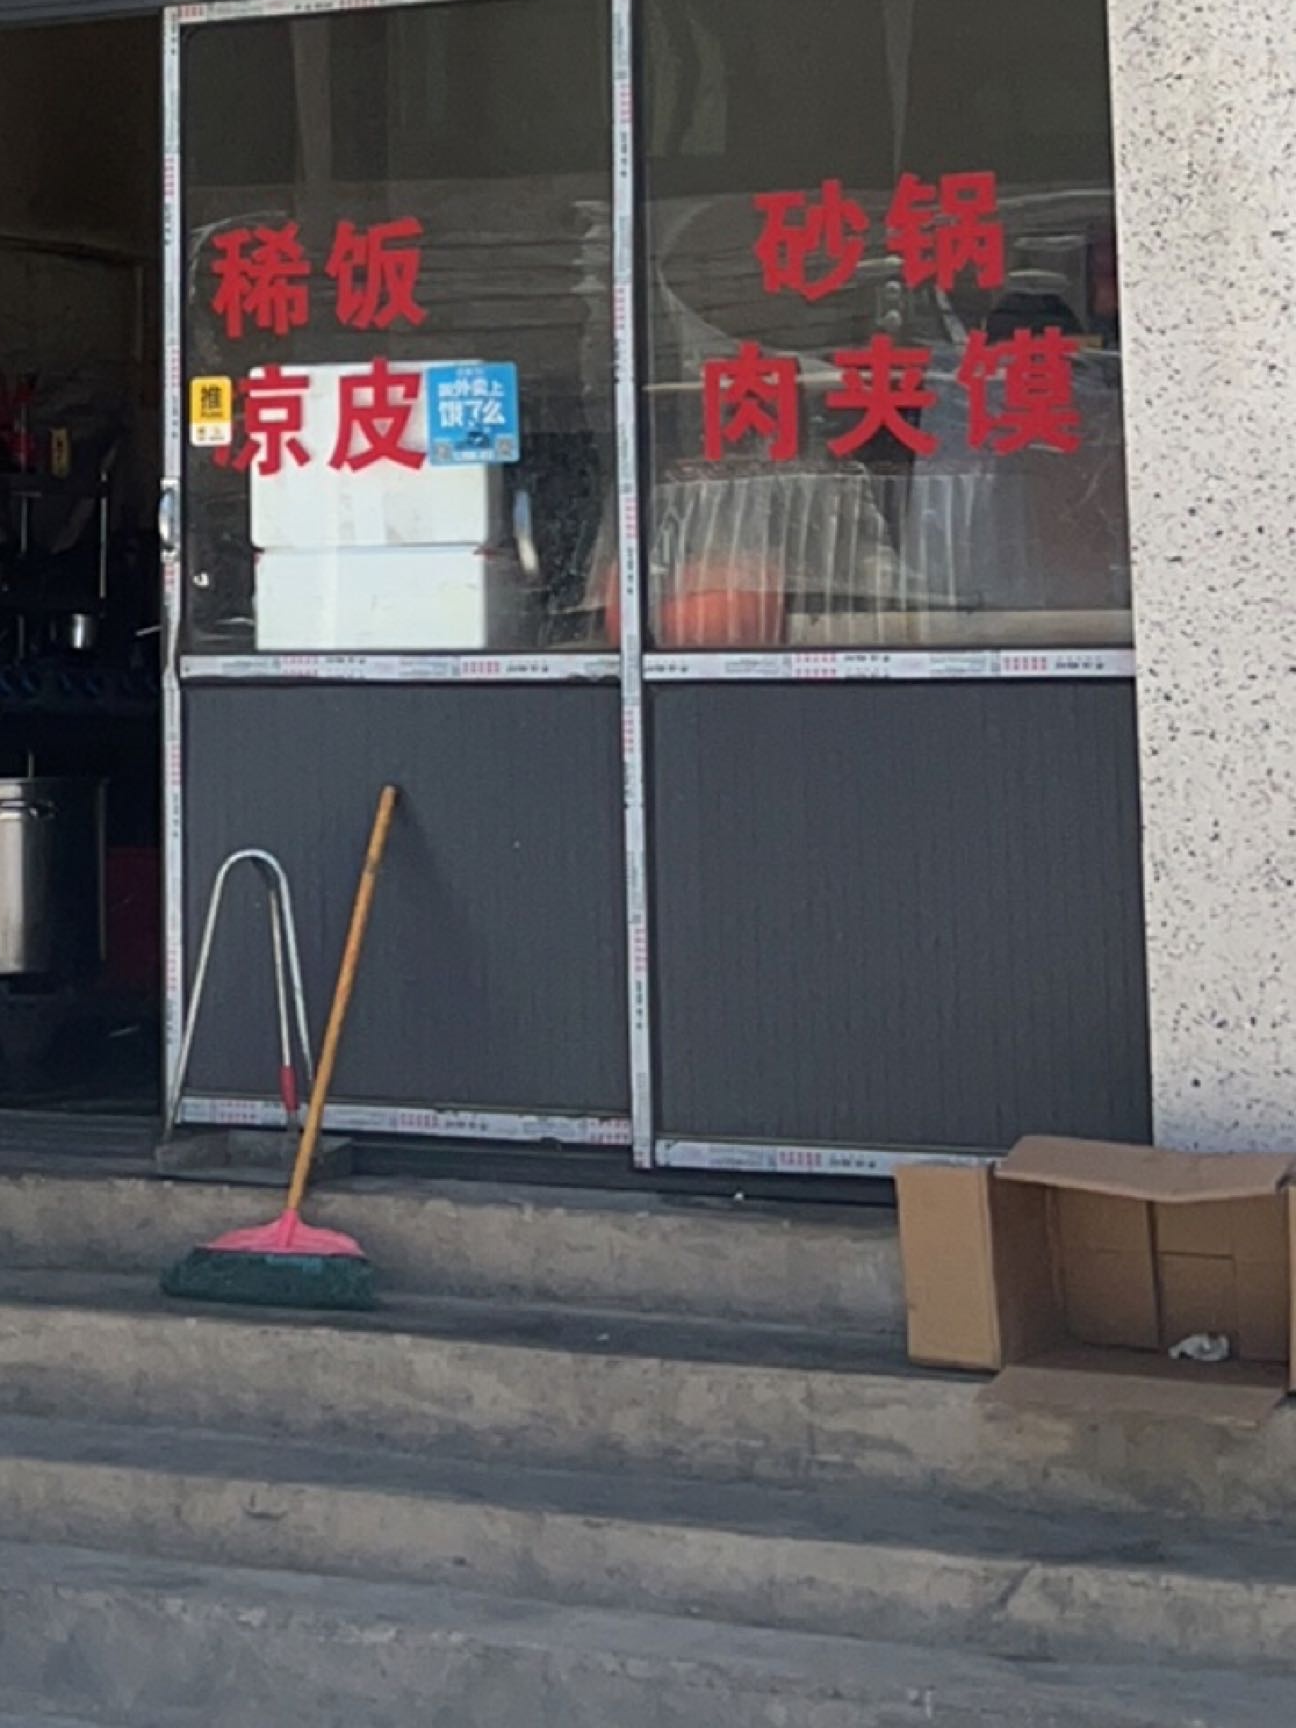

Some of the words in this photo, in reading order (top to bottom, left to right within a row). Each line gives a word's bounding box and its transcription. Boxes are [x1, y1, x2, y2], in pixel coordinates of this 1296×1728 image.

[212, 216, 427, 338] 稀饭
[753, 172, 1006, 302] 砂锅
[439, 398, 506, 428] 饿了么
[701, 326, 1082, 462] 肉夹馍
